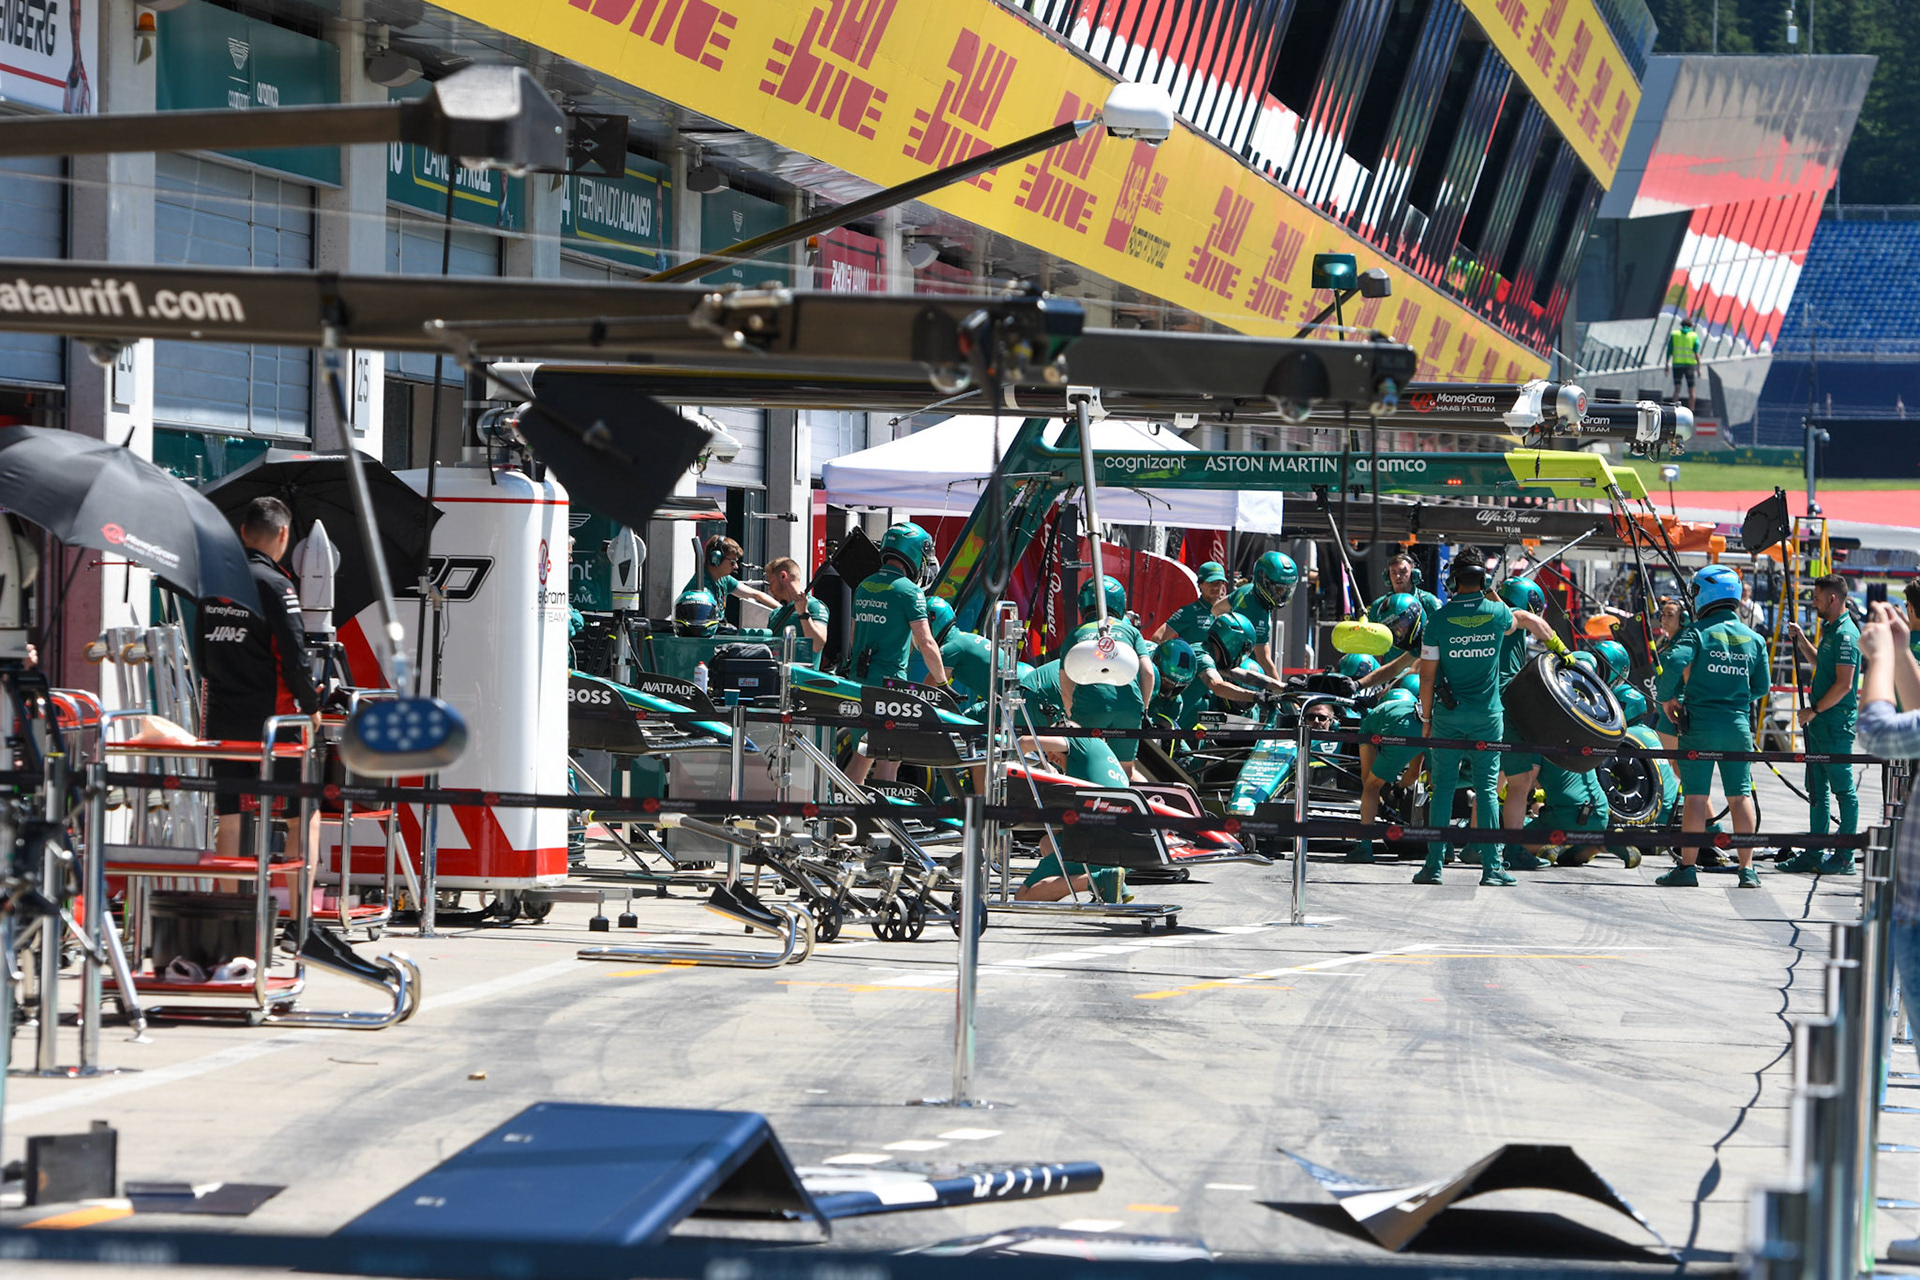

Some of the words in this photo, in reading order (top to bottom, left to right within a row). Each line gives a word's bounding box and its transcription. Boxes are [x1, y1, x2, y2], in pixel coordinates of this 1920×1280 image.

[1184, 185, 1255, 300] DHL
[1245, 221, 1306, 325] DHL
[356, 357, 370, 402] 25
[1436, 393, 1495, 405] MoneyGram
[1104, 455, 1186, 473] cognizant
[1204, 457, 1263, 472] ASTON
[1269, 457, 1337, 473] MARTIN
[1355, 458, 1427, 472] aramco
[1476, 510, 1503, 525] Alfa
[855, 598, 888, 611] cognizant
[855, 613, 887, 624] aramco
[204, 625, 248, 643] HAAS
[1449, 633, 1496, 645] cognizant
[1449, 647, 1496, 658] aramco
[568, 687, 612, 706] BOSS
[641, 681, 697, 697] AVATRADE
[840, 703, 862, 717] FIA
[874, 701, 923, 718] BOSS
